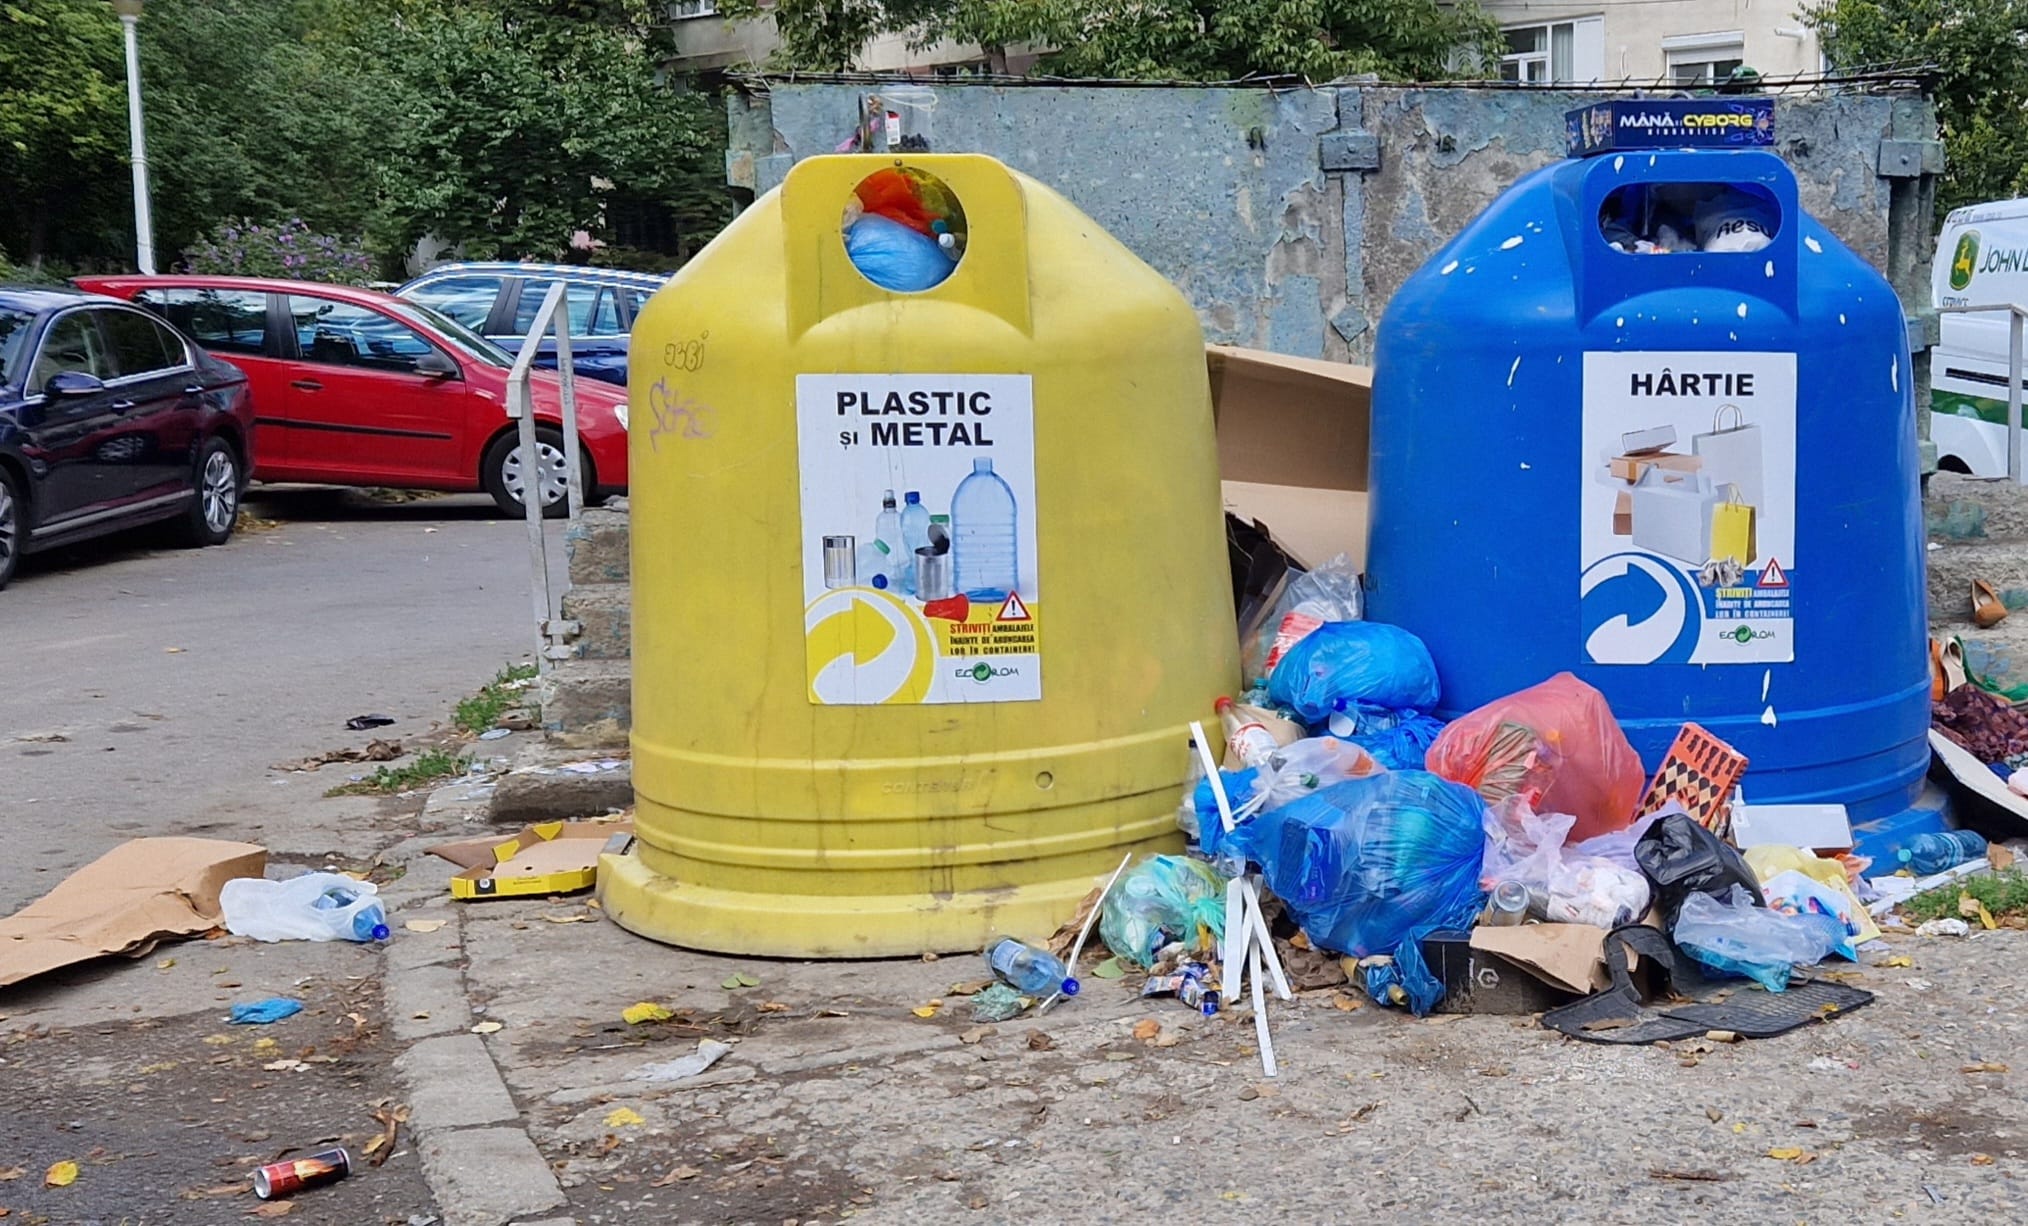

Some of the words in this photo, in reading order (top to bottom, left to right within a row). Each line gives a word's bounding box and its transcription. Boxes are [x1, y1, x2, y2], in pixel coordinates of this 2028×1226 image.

[1619, 111, 1674, 127] MÂNĂ
[1683, 114, 1753, 127] CYBORG
[1978, 245, 2023, 274] JOHN
[1630, 367, 1755, 397] HÂRTIE
[836, 391, 992, 416] PLASTIC
[871, 422, 994, 447] METAL
